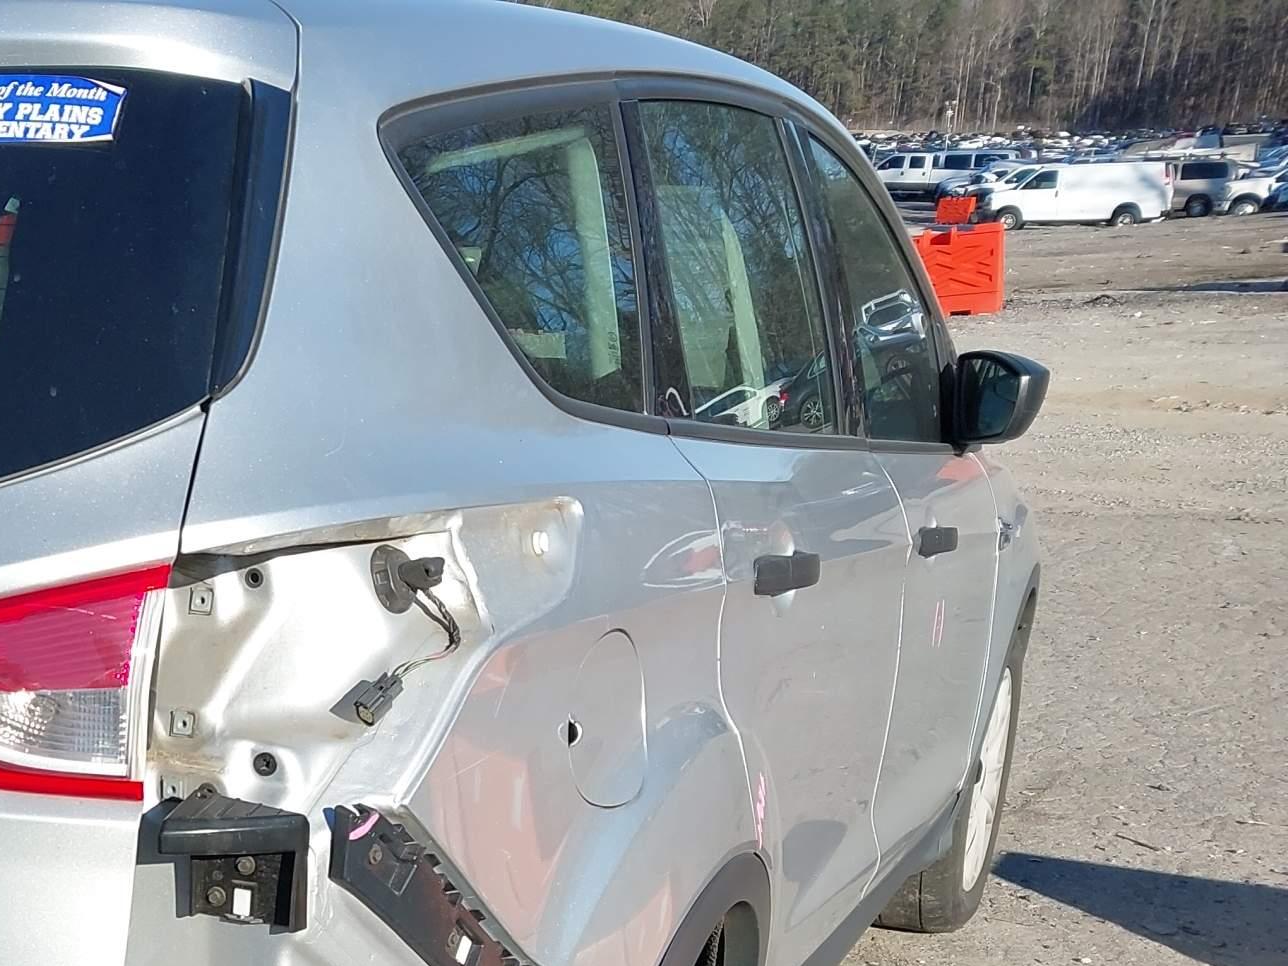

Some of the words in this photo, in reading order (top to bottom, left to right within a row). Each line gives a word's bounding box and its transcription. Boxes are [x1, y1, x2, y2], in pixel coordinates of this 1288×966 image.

[15, 81, 45, 97] the
[45, 82, 108, 102] Month
[14, 102, 104, 126] PLAINS
